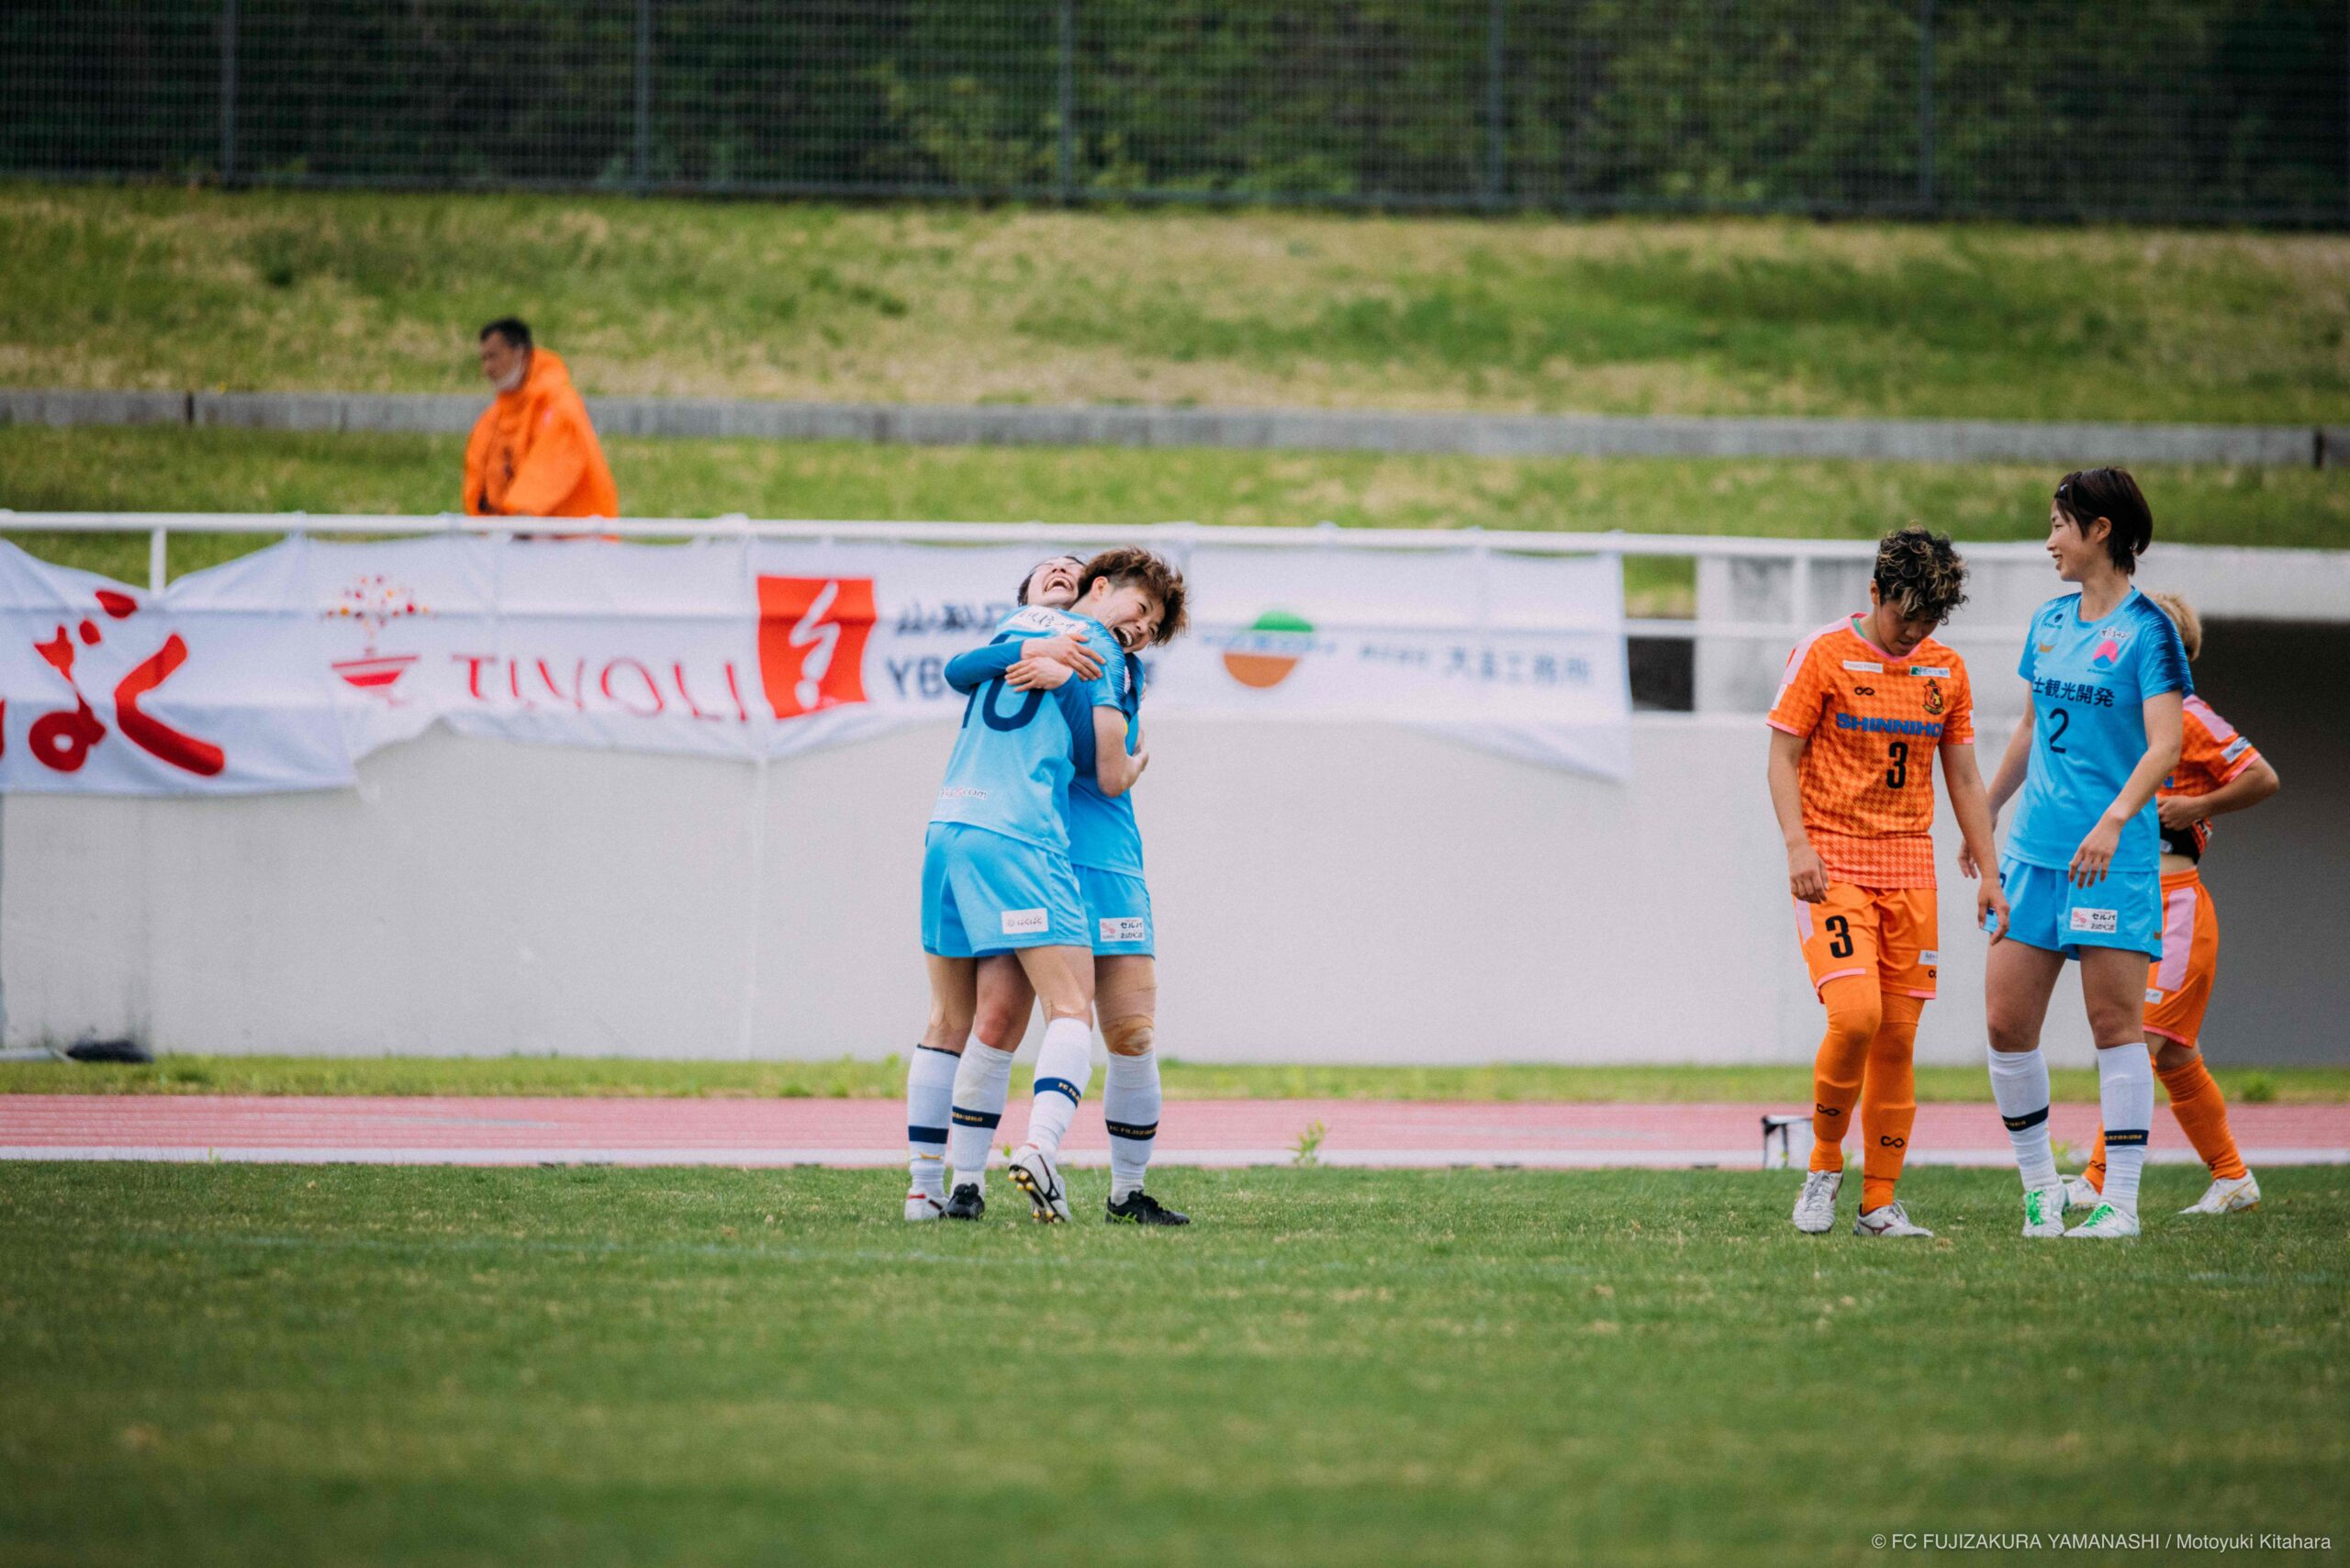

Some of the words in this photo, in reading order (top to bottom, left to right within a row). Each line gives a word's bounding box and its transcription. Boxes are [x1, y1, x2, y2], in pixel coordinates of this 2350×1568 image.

[451, 654, 748, 722] TIVOLI
[2033, 677, 2115, 707] 士観光開発
[1836, 712, 1943, 738] SHINNIHO
[2049, 708, 2069, 754] 2
[1886, 742, 1908, 789] 3
[1825, 914, 1853, 958] 3
